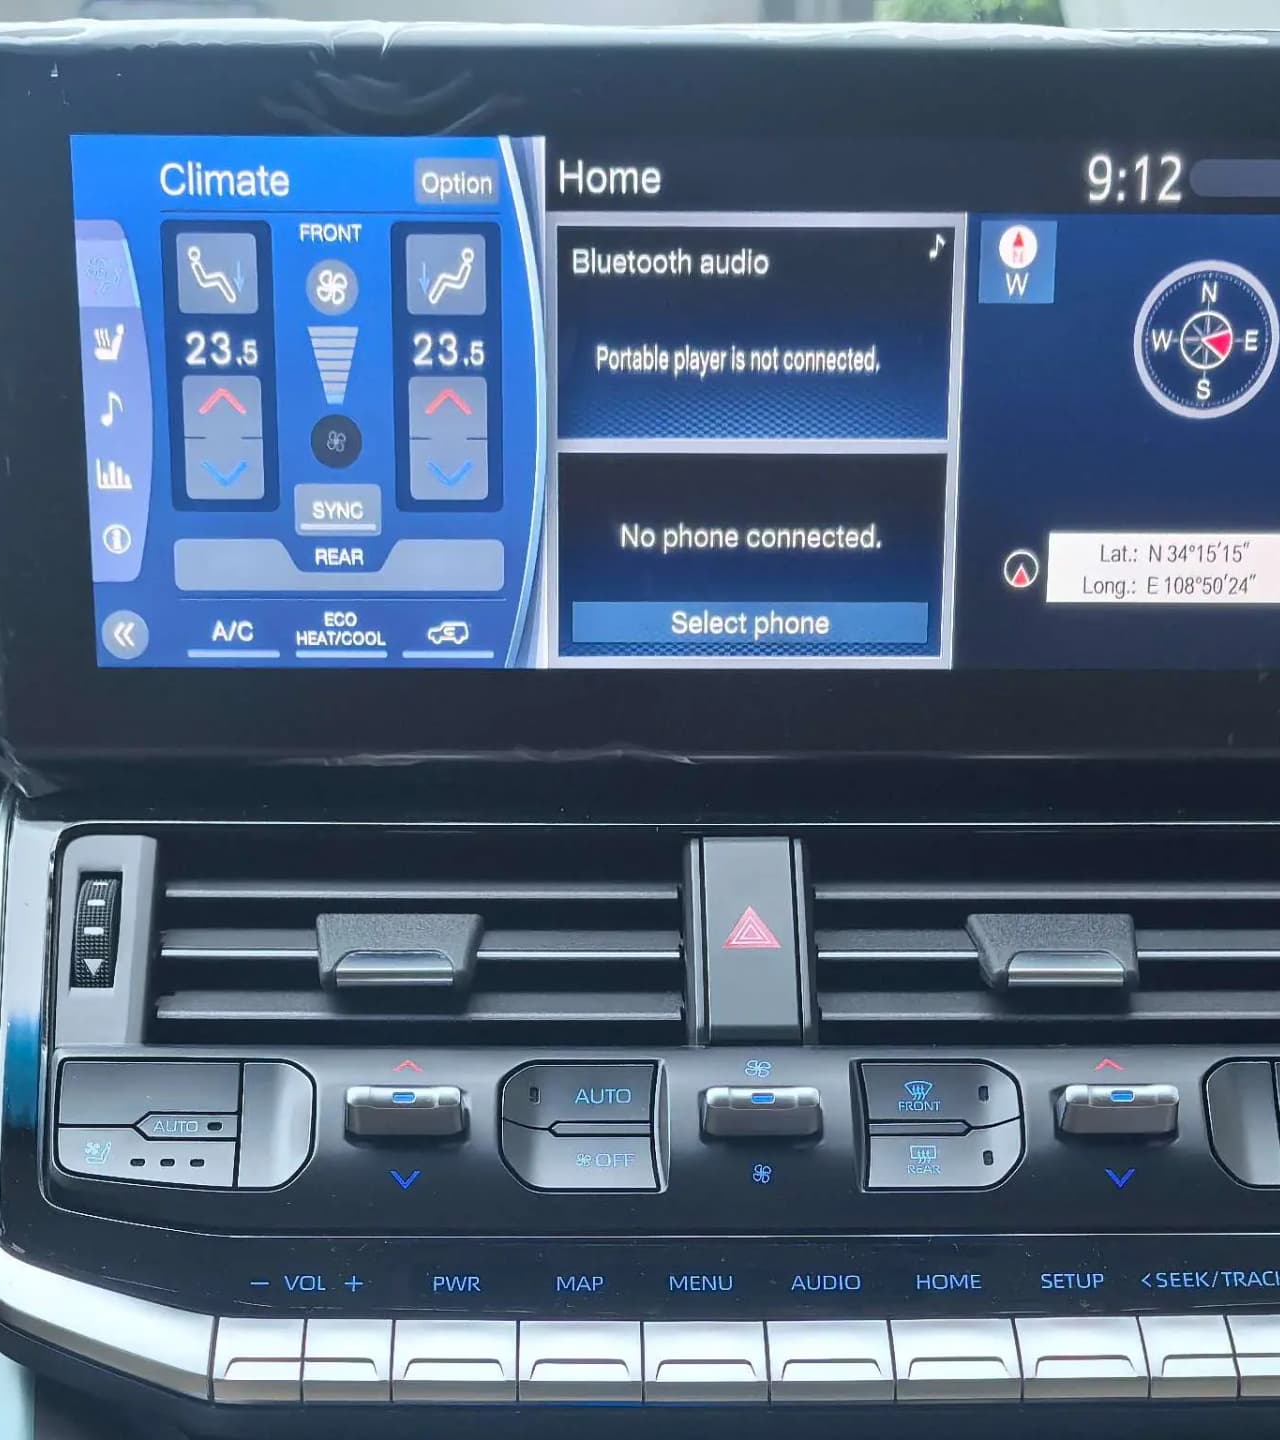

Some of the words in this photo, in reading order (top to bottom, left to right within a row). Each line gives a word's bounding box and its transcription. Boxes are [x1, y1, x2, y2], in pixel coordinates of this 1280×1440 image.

[159, 161, 291, 199] Climate
[421, 169, 494, 200] Option
[558, 158, 663, 195] Home
[1087, 153, 1183, 203] 9:12
[299, 223, 363, 243] FRONT
[571, 247, 693, 275] Bluetooth
[700, 248, 771, 276] audio
[1005, 273, 1030, 297] W
[1201, 281, 1218, 303] N
[184, 331, 258, 366] 23.5
[412, 332, 486, 367] 23.5
[1151, 330, 1174, 350] W
[1244, 330, 1259, 351] E
[595, 345, 670, 373] Portable
[673, 347, 727, 379] player
[731, 347, 745, 371] is
[749, 349, 779, 371] not
[783, 346, 881, 374] connected.
[1196, 378, 1212, 400] S
[312, 500, 364, 520] SYNC
[620, 525, 656, 549] No
[663, 525, 739, 554] phone
[746, 525, 883, 550] connected.
[314, 547, 365, 567] REAR
[1148, 544, 1166, 564] N
[1147, 575, 1160, 595] E
[324, 612, 358, 629] ECO
[670, 611, 748, 636] Select
[754, 610, 831, 640] phone
[212, 622, 254, 643] A/C
[295, 631, 387, 648] HEAT/COOL
[574, 1088, 632, 1104] AUTO
[898, 1101, 940, 1112] FRONT
[153, 1120, 198, 1134] AUTO
[596, 1154, 635, 1168] OFF
[907, 1164, 941, 1175] REAR
[284, 1274, 327, 1291] VOL
[432, 1275, 482, 1292] PWR
[556, 1275, 604, 1292] MAP
[668, 1275, 734, 1292] MENU
[790, 1274, 862, 1291] AUDIO
[915, 1273, 982, 1290] HOME
[1040, 1272, 1105, 1290] SETUP
